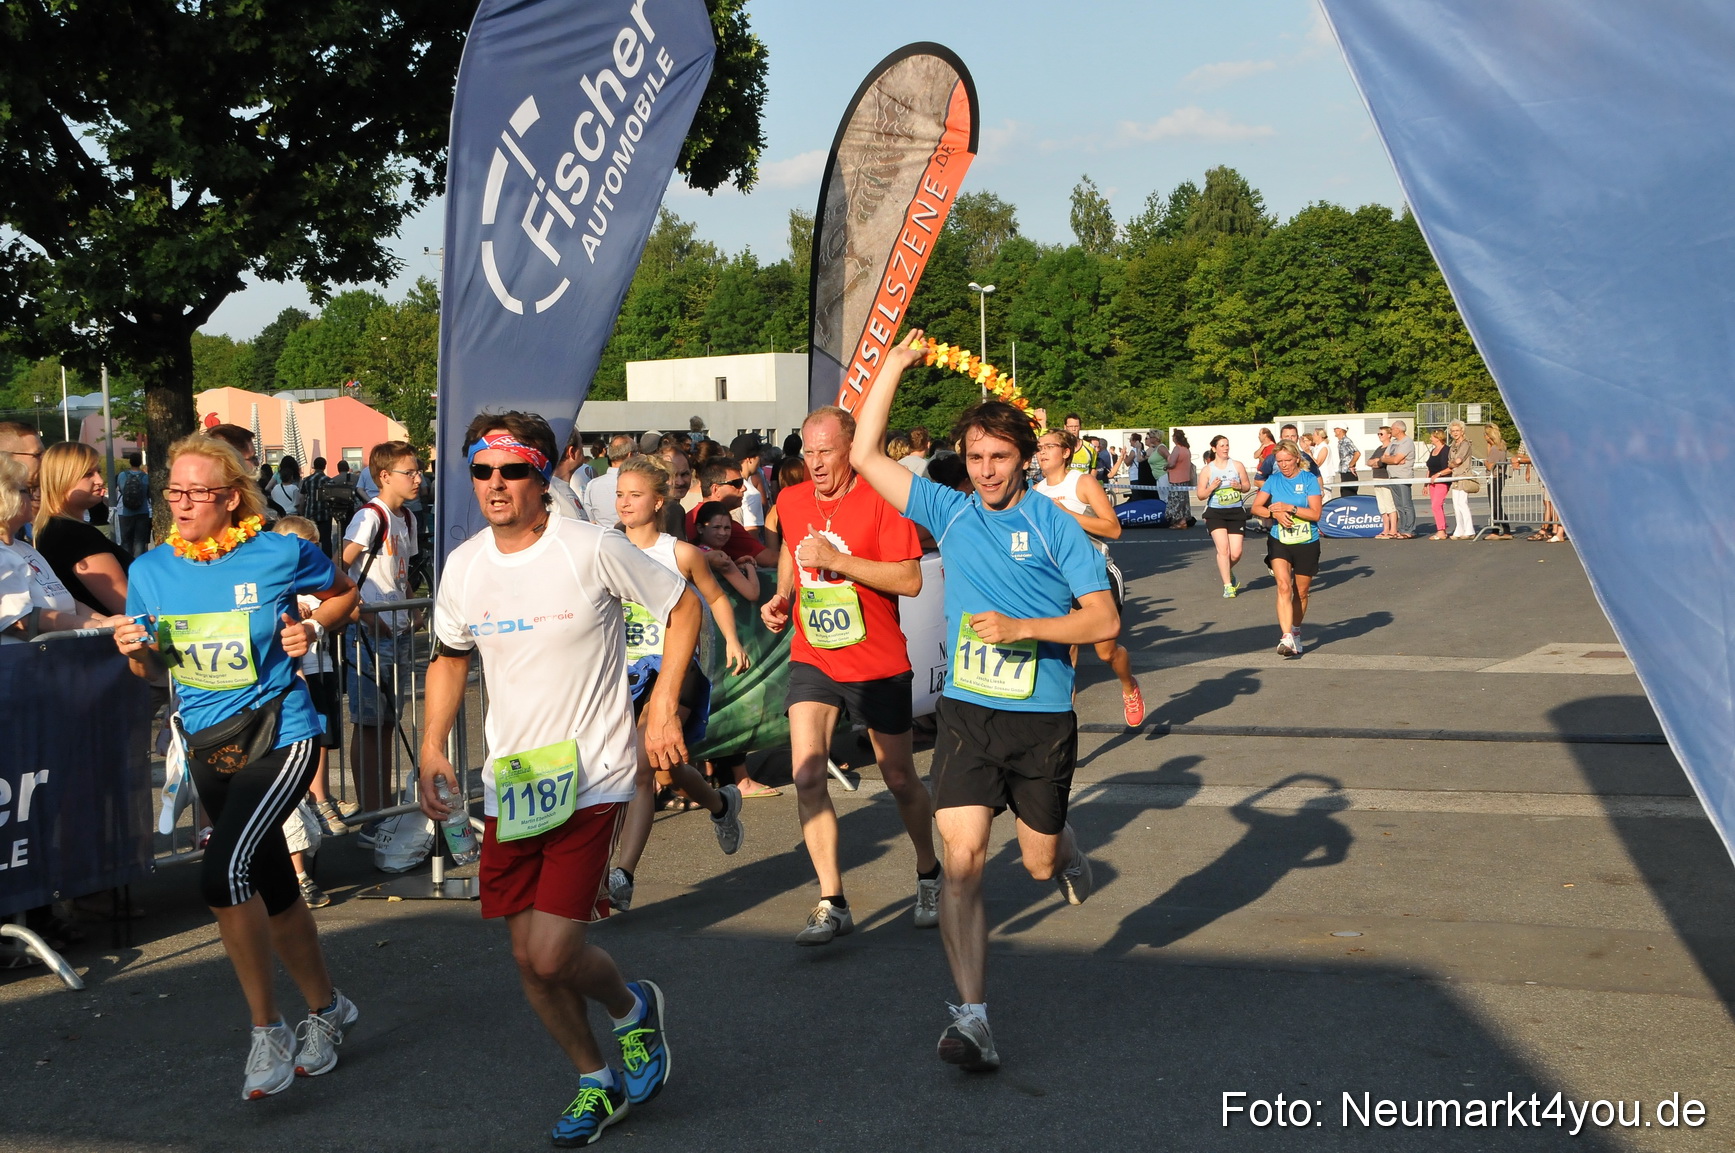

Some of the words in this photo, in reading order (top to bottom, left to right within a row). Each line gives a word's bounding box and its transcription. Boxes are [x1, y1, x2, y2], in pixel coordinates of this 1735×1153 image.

[521, 0, 656, 267] Fischer
[580, 46, 675, 265] AUTOMOBILE
[1219, 492, 1240, 502] 1210
[1341, 522, 1383, 530] AUTOMOBILE
[808, 608, 851, 633] 460
[164, 641, 249, 672] 1173
[959, 641, 1033, 680] 1177
[0, 769, 49, 828] r
[501, 771, 574, 821] 1187
